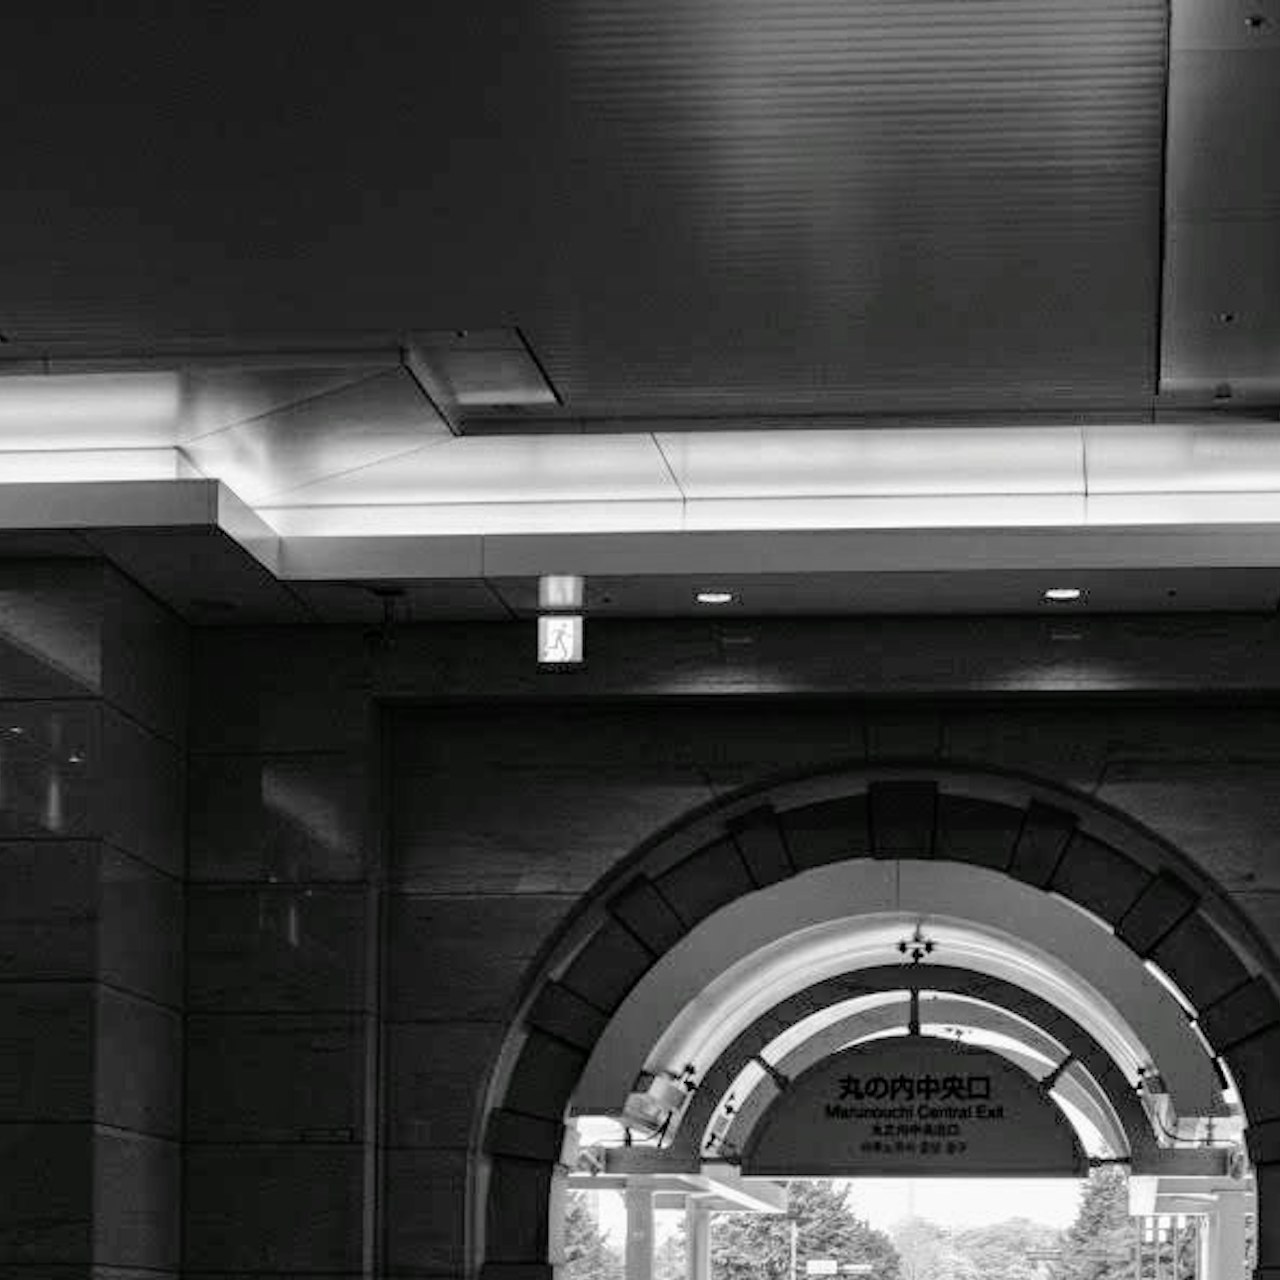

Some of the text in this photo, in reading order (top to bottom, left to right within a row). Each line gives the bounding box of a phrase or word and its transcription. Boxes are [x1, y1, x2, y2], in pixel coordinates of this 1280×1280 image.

[838, 1075, 990, 1101] 丸の内中央口
[826, 1104, 1004, 1120] Marunouchi Central Exit
